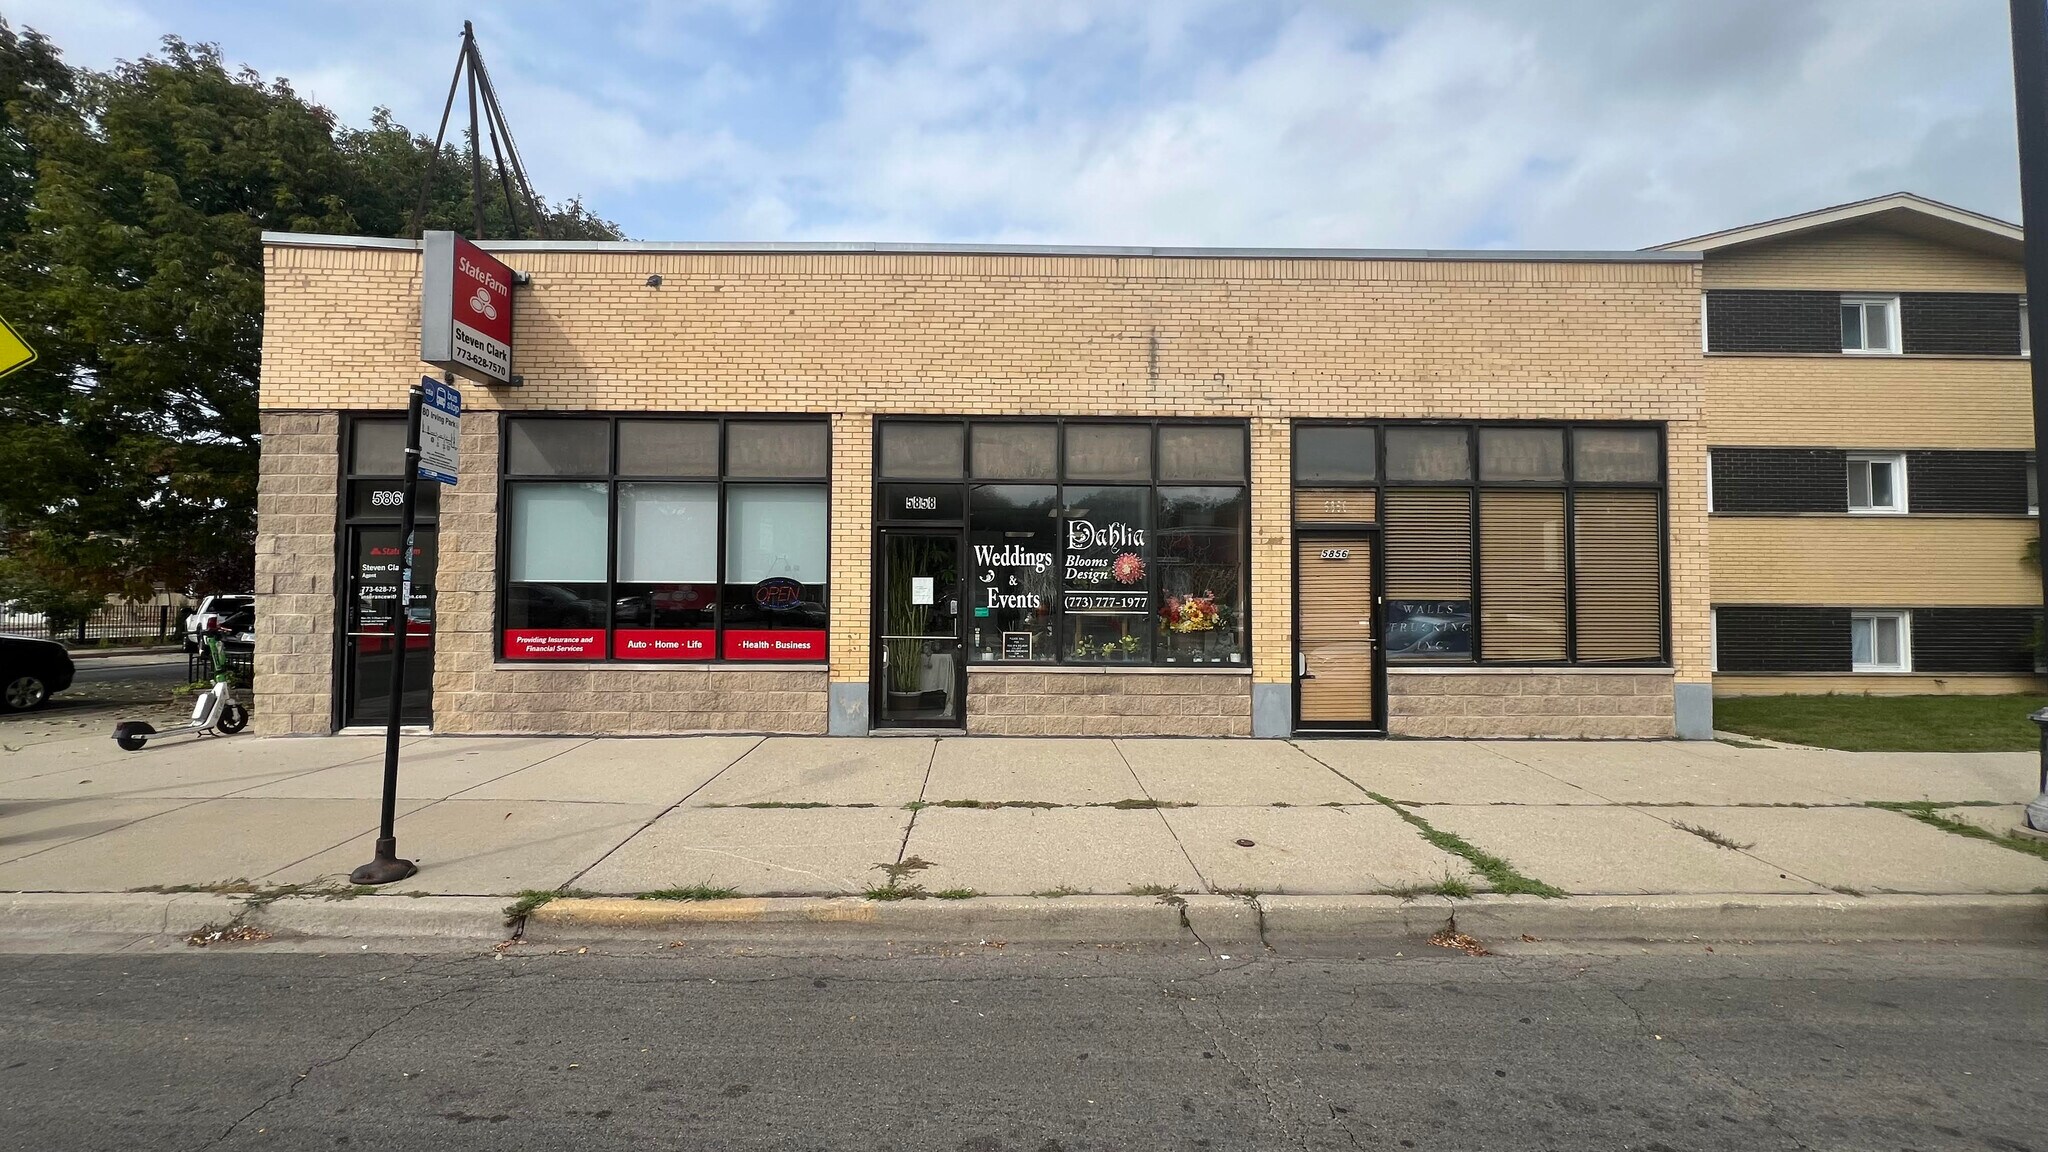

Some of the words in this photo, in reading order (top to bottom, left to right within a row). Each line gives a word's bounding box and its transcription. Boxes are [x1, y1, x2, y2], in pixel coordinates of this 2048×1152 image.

[455, 328, 485, 351] Steven
[486, 342, 508, 362] Clark
[456, 346, 506, 376] 773-628-7570
[447, 390, 458, 403] bus
[446, 401, 460, 415] stop
[430, 411, 445, 425] Irving
[445, 417, 456, 427] Park
[905, 496, 937, 510] 5858
[1066, 519, 1146, 554] Dahlia
[973, 545, 1052, 574] Weddings
[1064, 555, 1108, 567] Blooms
[1321, 549, 1350, 559] 5856
[362, 563, 386, 571] Steven
[387, 563, 400, 571] Cla
[1008, 575, 1018, 586] &
[1064, 567, 1108, 583] Design
[756, 586, 801, 602] OPEN
[986, 586, 1041, 609] Events
[1064, 596, 1093, 610] (773)
[1095, 596, 1148, 609] 777-1977
[1403, 604, 1455, 614] WALLS
[1389, 622, 1470, 632] TRUCKING
[516, 636, 547, 644] Providing
[627, 640, 647, 648] Auto
[654, 640, 680, 649] Home
[686, 640, 703, 649] Life
[742, 641, 770, 649] Health
[775, 641, 811, 649] Business
